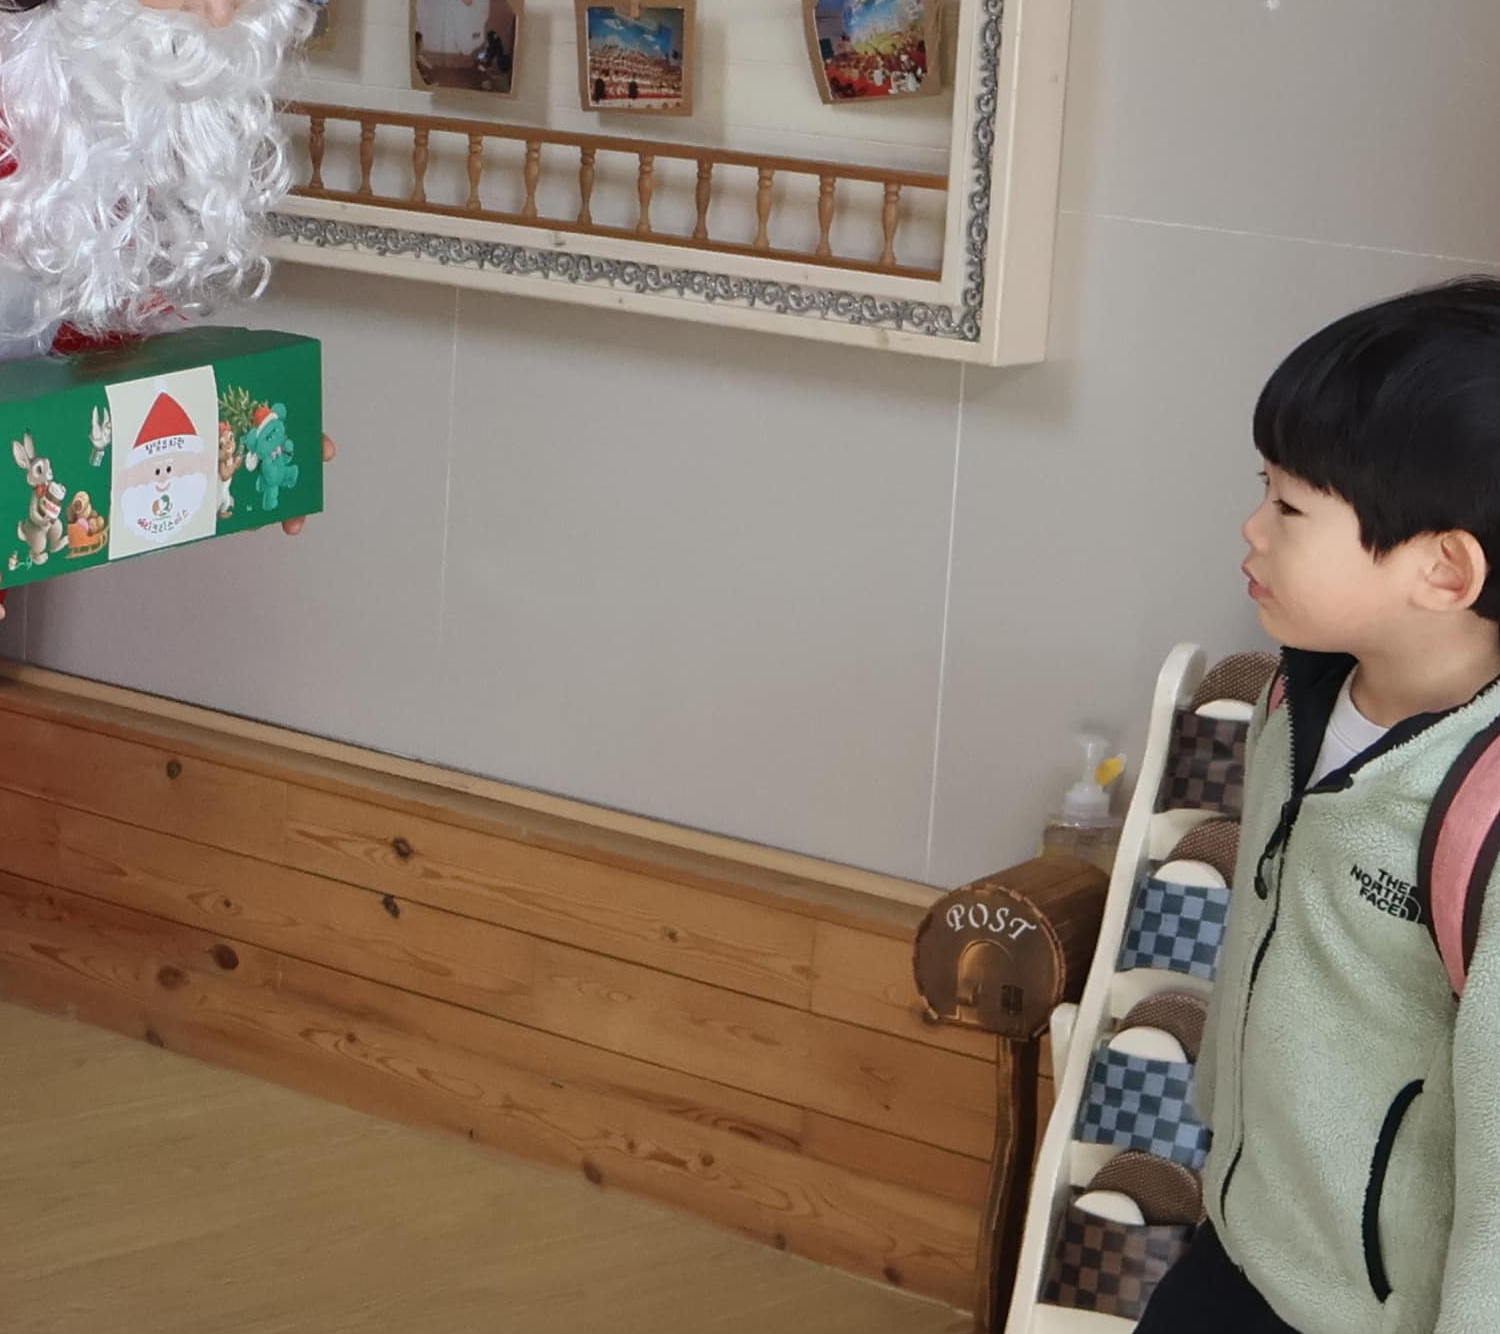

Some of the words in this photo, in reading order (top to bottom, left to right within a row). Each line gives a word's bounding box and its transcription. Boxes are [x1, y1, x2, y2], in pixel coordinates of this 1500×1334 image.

[1350, 863, 1406, 906] NORTH
[1377, 867, 1411, 896] THE
[1359, 886, 1402, 917] FACE
[945, 902, 1037, 940] POST
